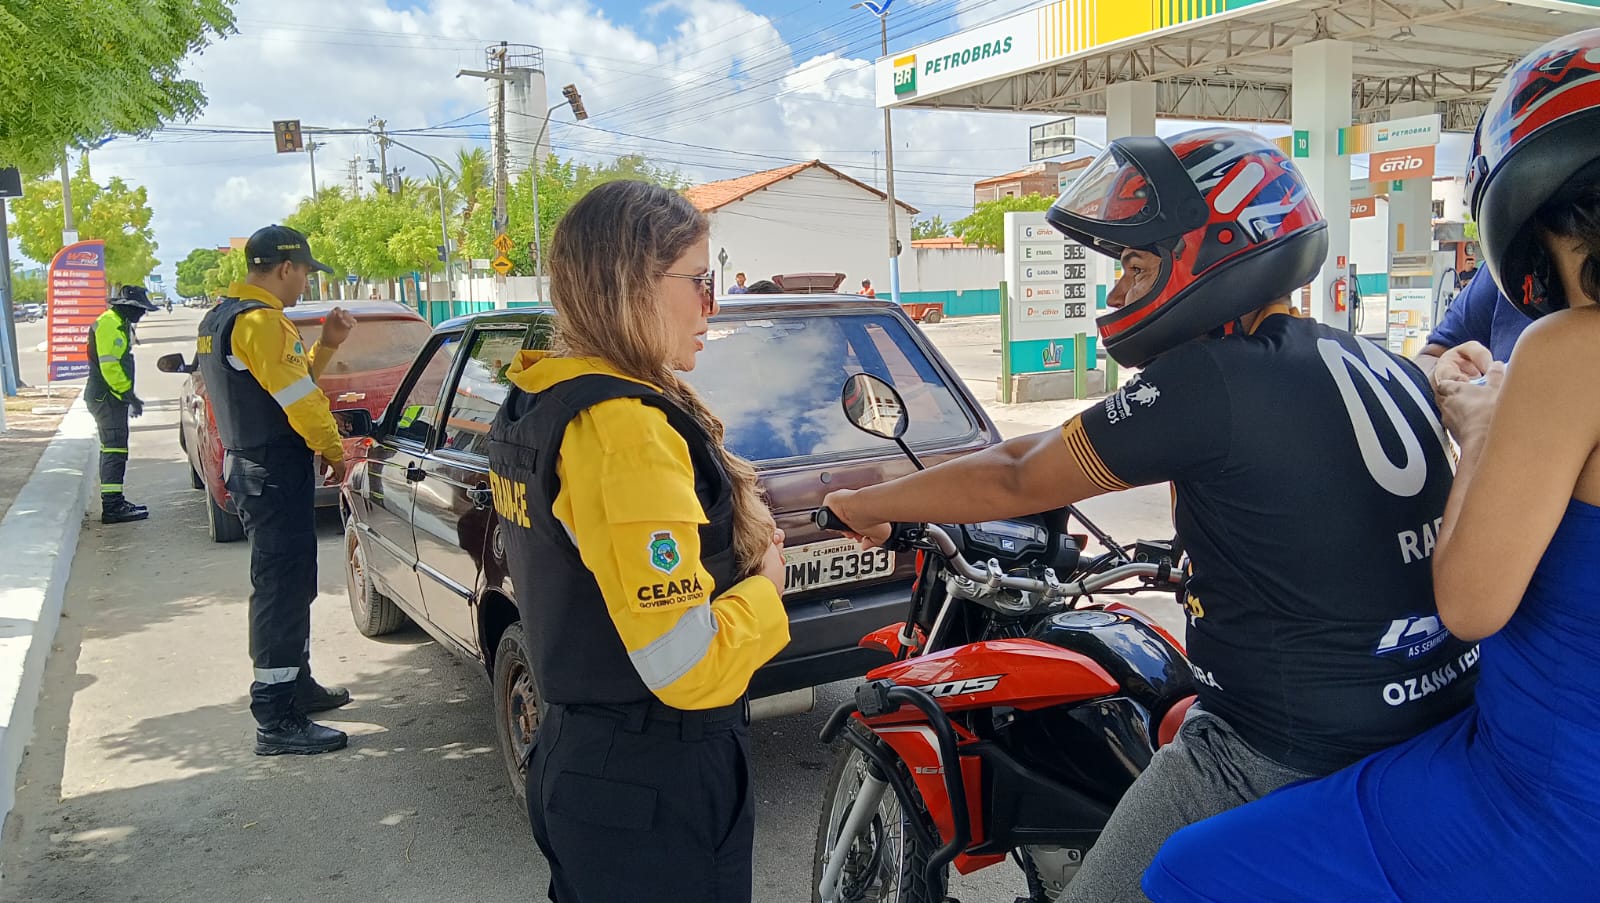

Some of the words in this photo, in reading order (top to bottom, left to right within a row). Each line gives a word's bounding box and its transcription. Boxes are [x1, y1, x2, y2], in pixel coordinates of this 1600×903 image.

[894, 68, 912, 86] BR
[924, 36, 1013, 76] PETROBRAS
[1391, 126, 1432, 137] PETROBRAS
[1299, 138, 1307, 149] 10
[1025, 227, 1032, 237] G
[1025, 248, 1032, 258] E
[1064, 246, 1085, 258] 5,59
[1026, 268, 1033, 278] G
[1064, 265, 1086, 278] 6,75
[1026, 288, 1033, 297] D
[1064, 285, 1085, 298] 6,69
[1027, 307, 1034, 316] D
[1065, 304, 1086, 317] 6,69
[637, 572, 703, 601] CEARÁ
[640, 598, 675, 608] GOVERNO
[676, 595, 686, 603] DO
[1382, 662, 1458, 706] OZANA
